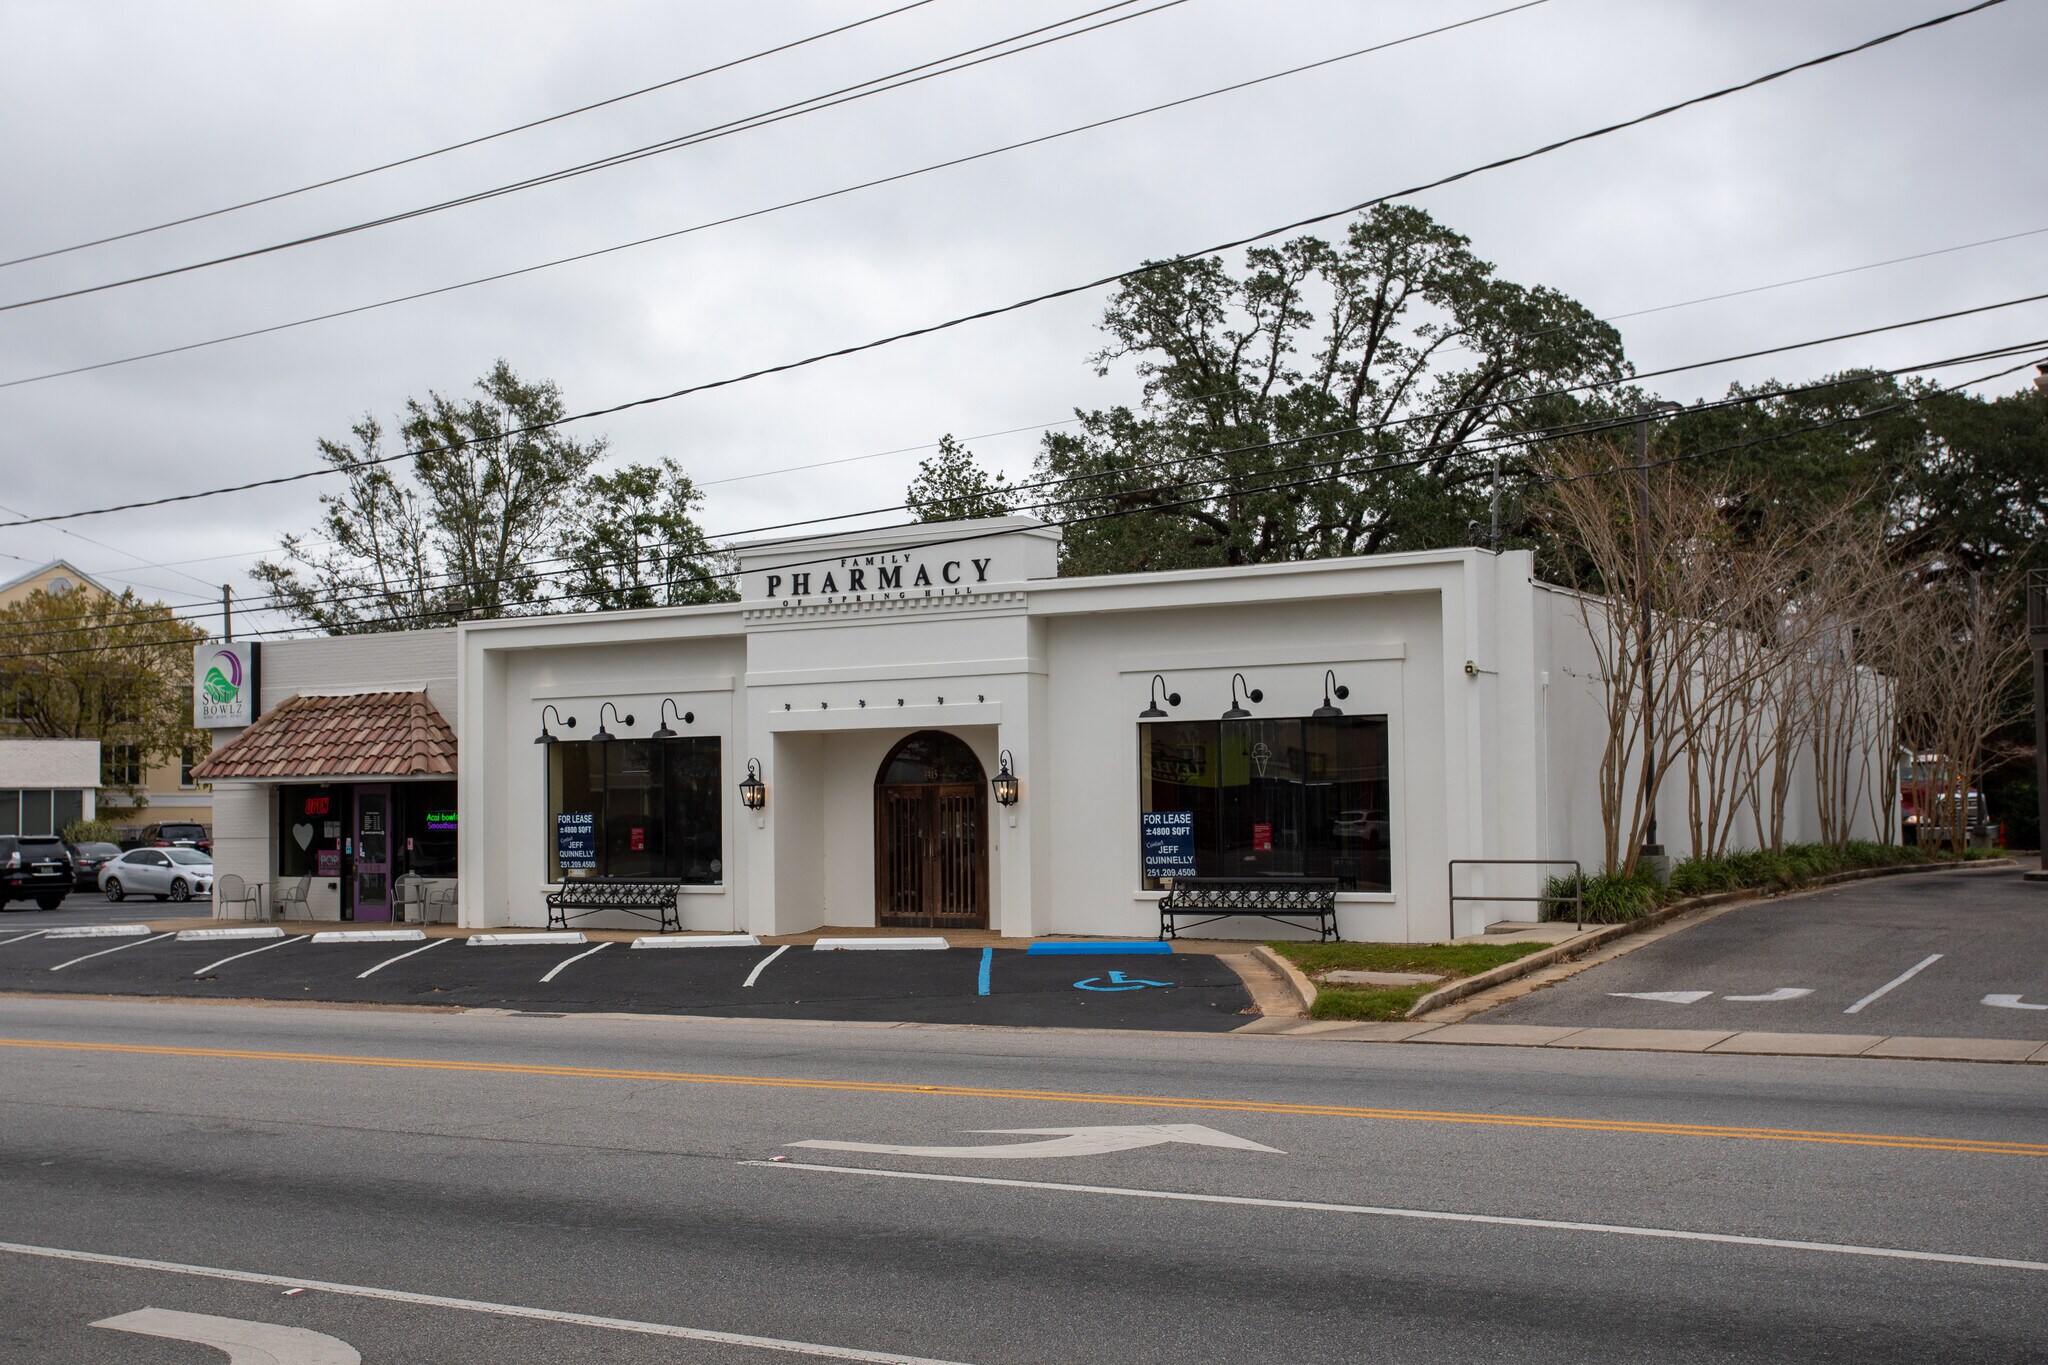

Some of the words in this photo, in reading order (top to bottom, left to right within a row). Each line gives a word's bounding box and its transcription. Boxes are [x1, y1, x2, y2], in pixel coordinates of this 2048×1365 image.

[841, 554, 911, 567] FAMILY
[767, 558, 991, 597] PHARMACY
[782, 599, 803, 607] OF
[827, 592, 906, 604] SPRING
[924, 587, 972, 597] HILL
[203, 690, 242, 705] SOUL
[203, 704, 242, 715] BOWLZ
[305, 798, 329, 814] OPEN
[558, 815, 571, 824] FOR
[572, 815, 592, 824] LEASE
[1143, 814, 1161, 825] FOR
[1163, 813, 1191, 824] LEASE
[578, 826, 592, 834] SQFT
[1145, 827, 1170, 836] ±4800
[1171, 827, 1190, 836] SQFT
[568, 841, 583, 849] JEFF
[1146, 840, 1164, 849] Contact
[559, 850, 594, 858] QUINNELLY
[1158, 845, 1179, 854] JEFF
[1145, 856, 1194, 865] QUINNELLY
[1146, 868, 1196, 877] 251.209.4500
